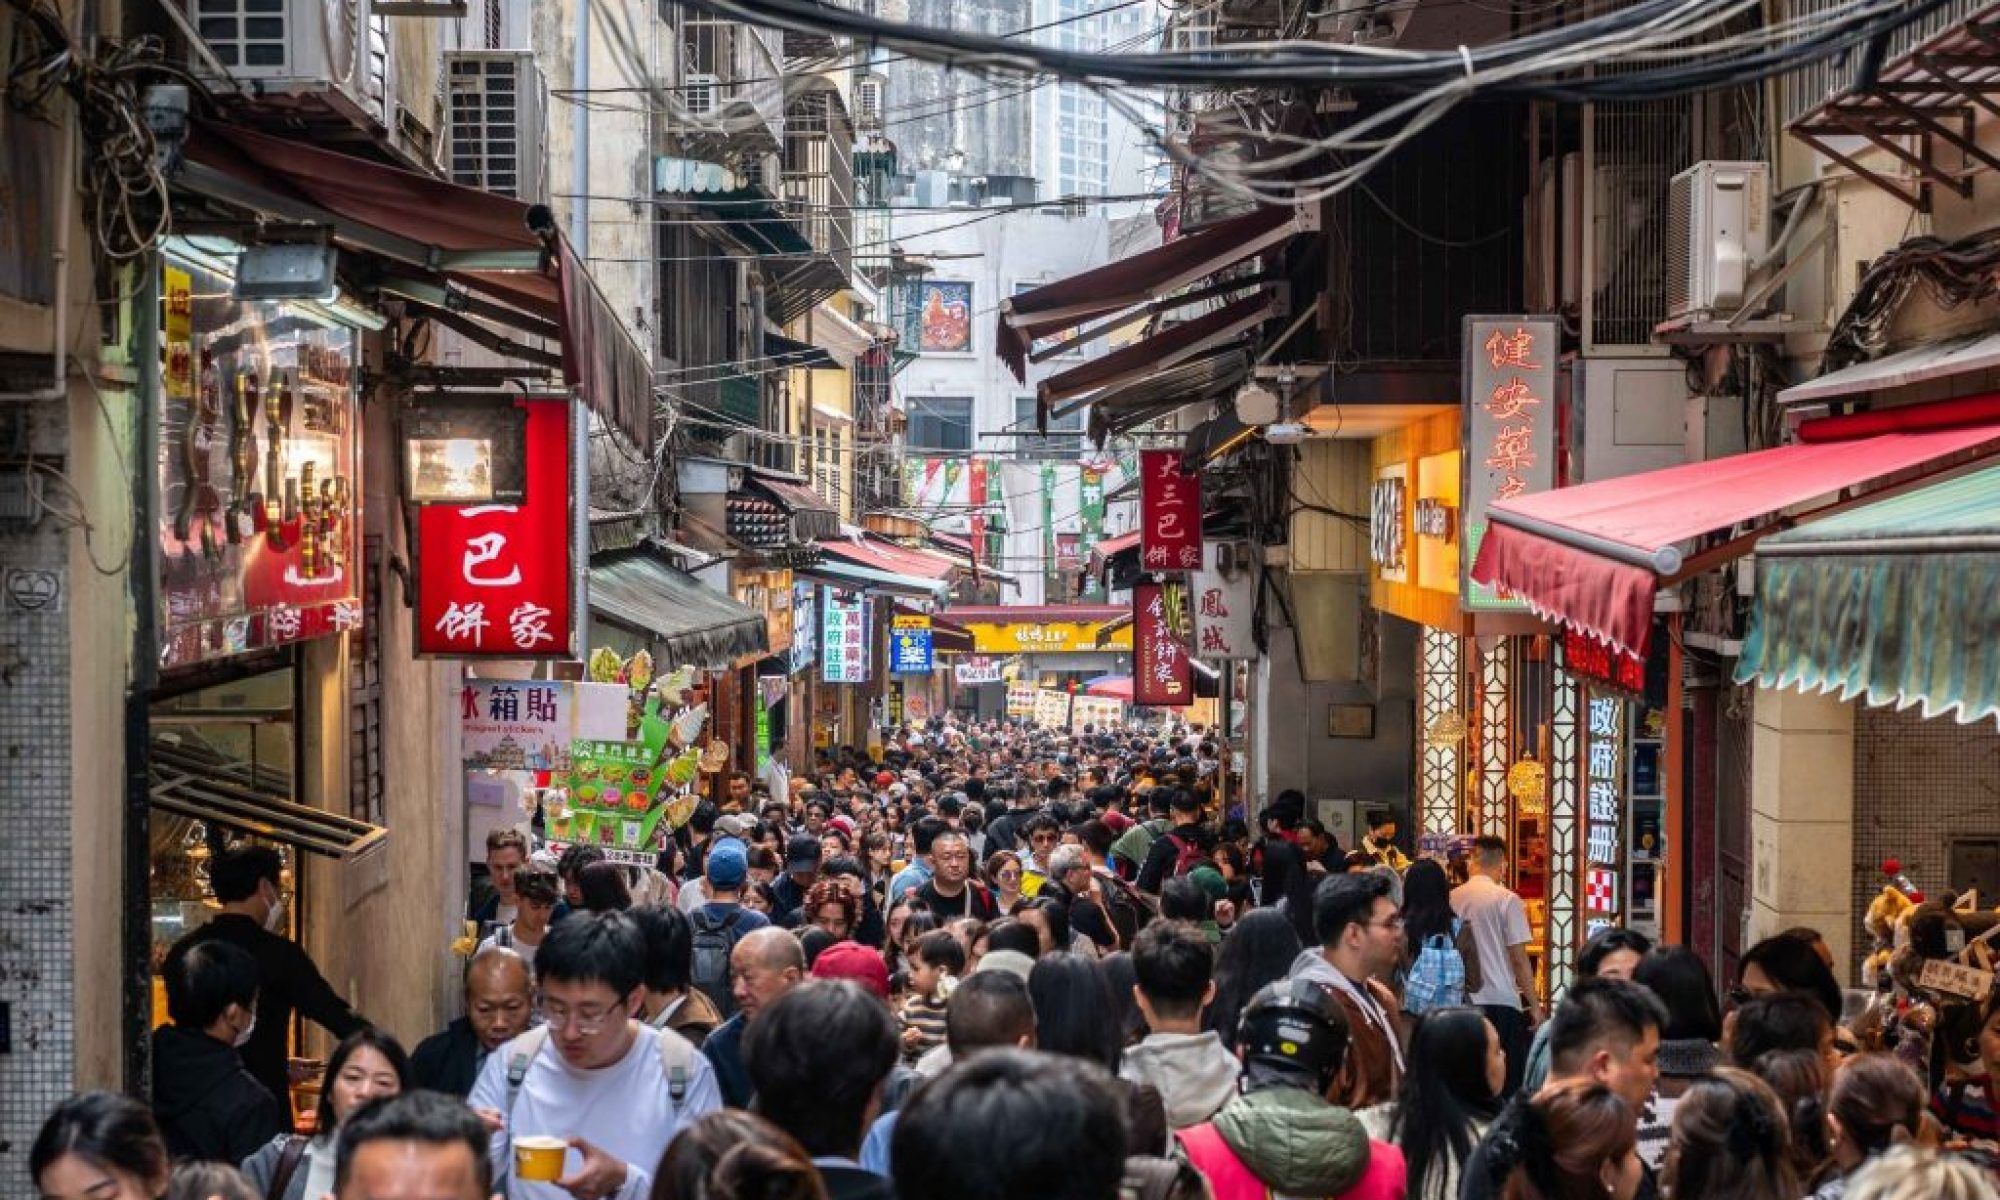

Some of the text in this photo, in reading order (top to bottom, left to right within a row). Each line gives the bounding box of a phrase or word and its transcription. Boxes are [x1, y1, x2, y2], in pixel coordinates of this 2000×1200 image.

[1156, 455, 1185, 539] 大三巴
[459, 505, 522, 586] 巴
[1145, 545, 1200, 567] 餅家
[435, 601, 554, 648] 餅家
[1199, 588, 1231, 653] 鳳城
